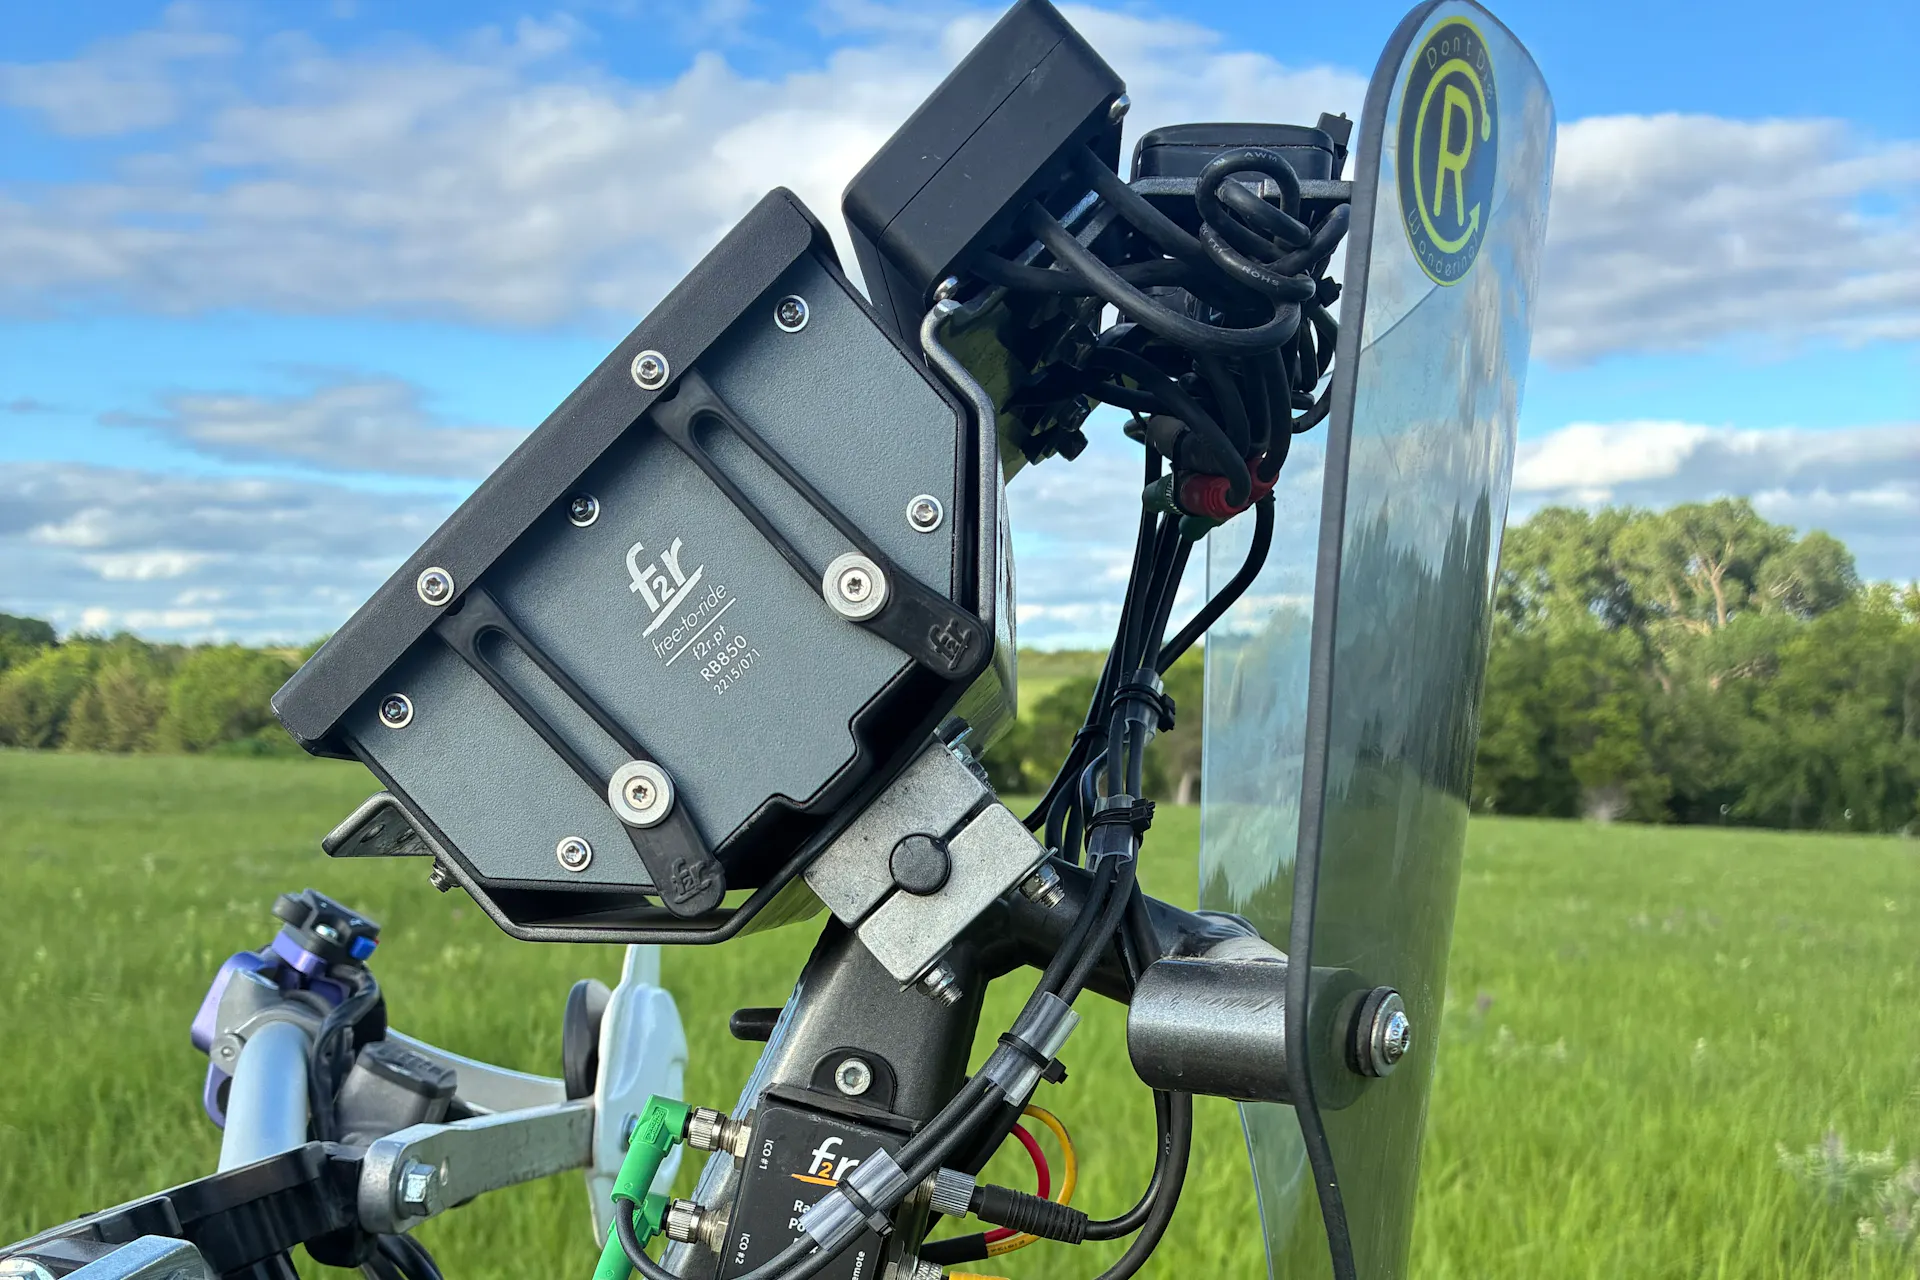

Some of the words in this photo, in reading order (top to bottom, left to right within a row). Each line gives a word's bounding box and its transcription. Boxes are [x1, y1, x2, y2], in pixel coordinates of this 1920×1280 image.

[1244, 151, 1278, 162] AWM
[626, 537, 686, 613] f2r
[652, 584, 727, 659] free-to-ride
[692, 625, 727, 660] f2r.pt
[700, 635, 747, 682] RB850
[713, 648, 761, 695] 2215/071
[759, 1158, 769, 1170] #1
[762, 1139, 774, 1157] ICO
[808, 1136, 860, 1181] f2r
[734, 1251, 746, 1265] #2
[739, 1232, 751, 1251] ICO
